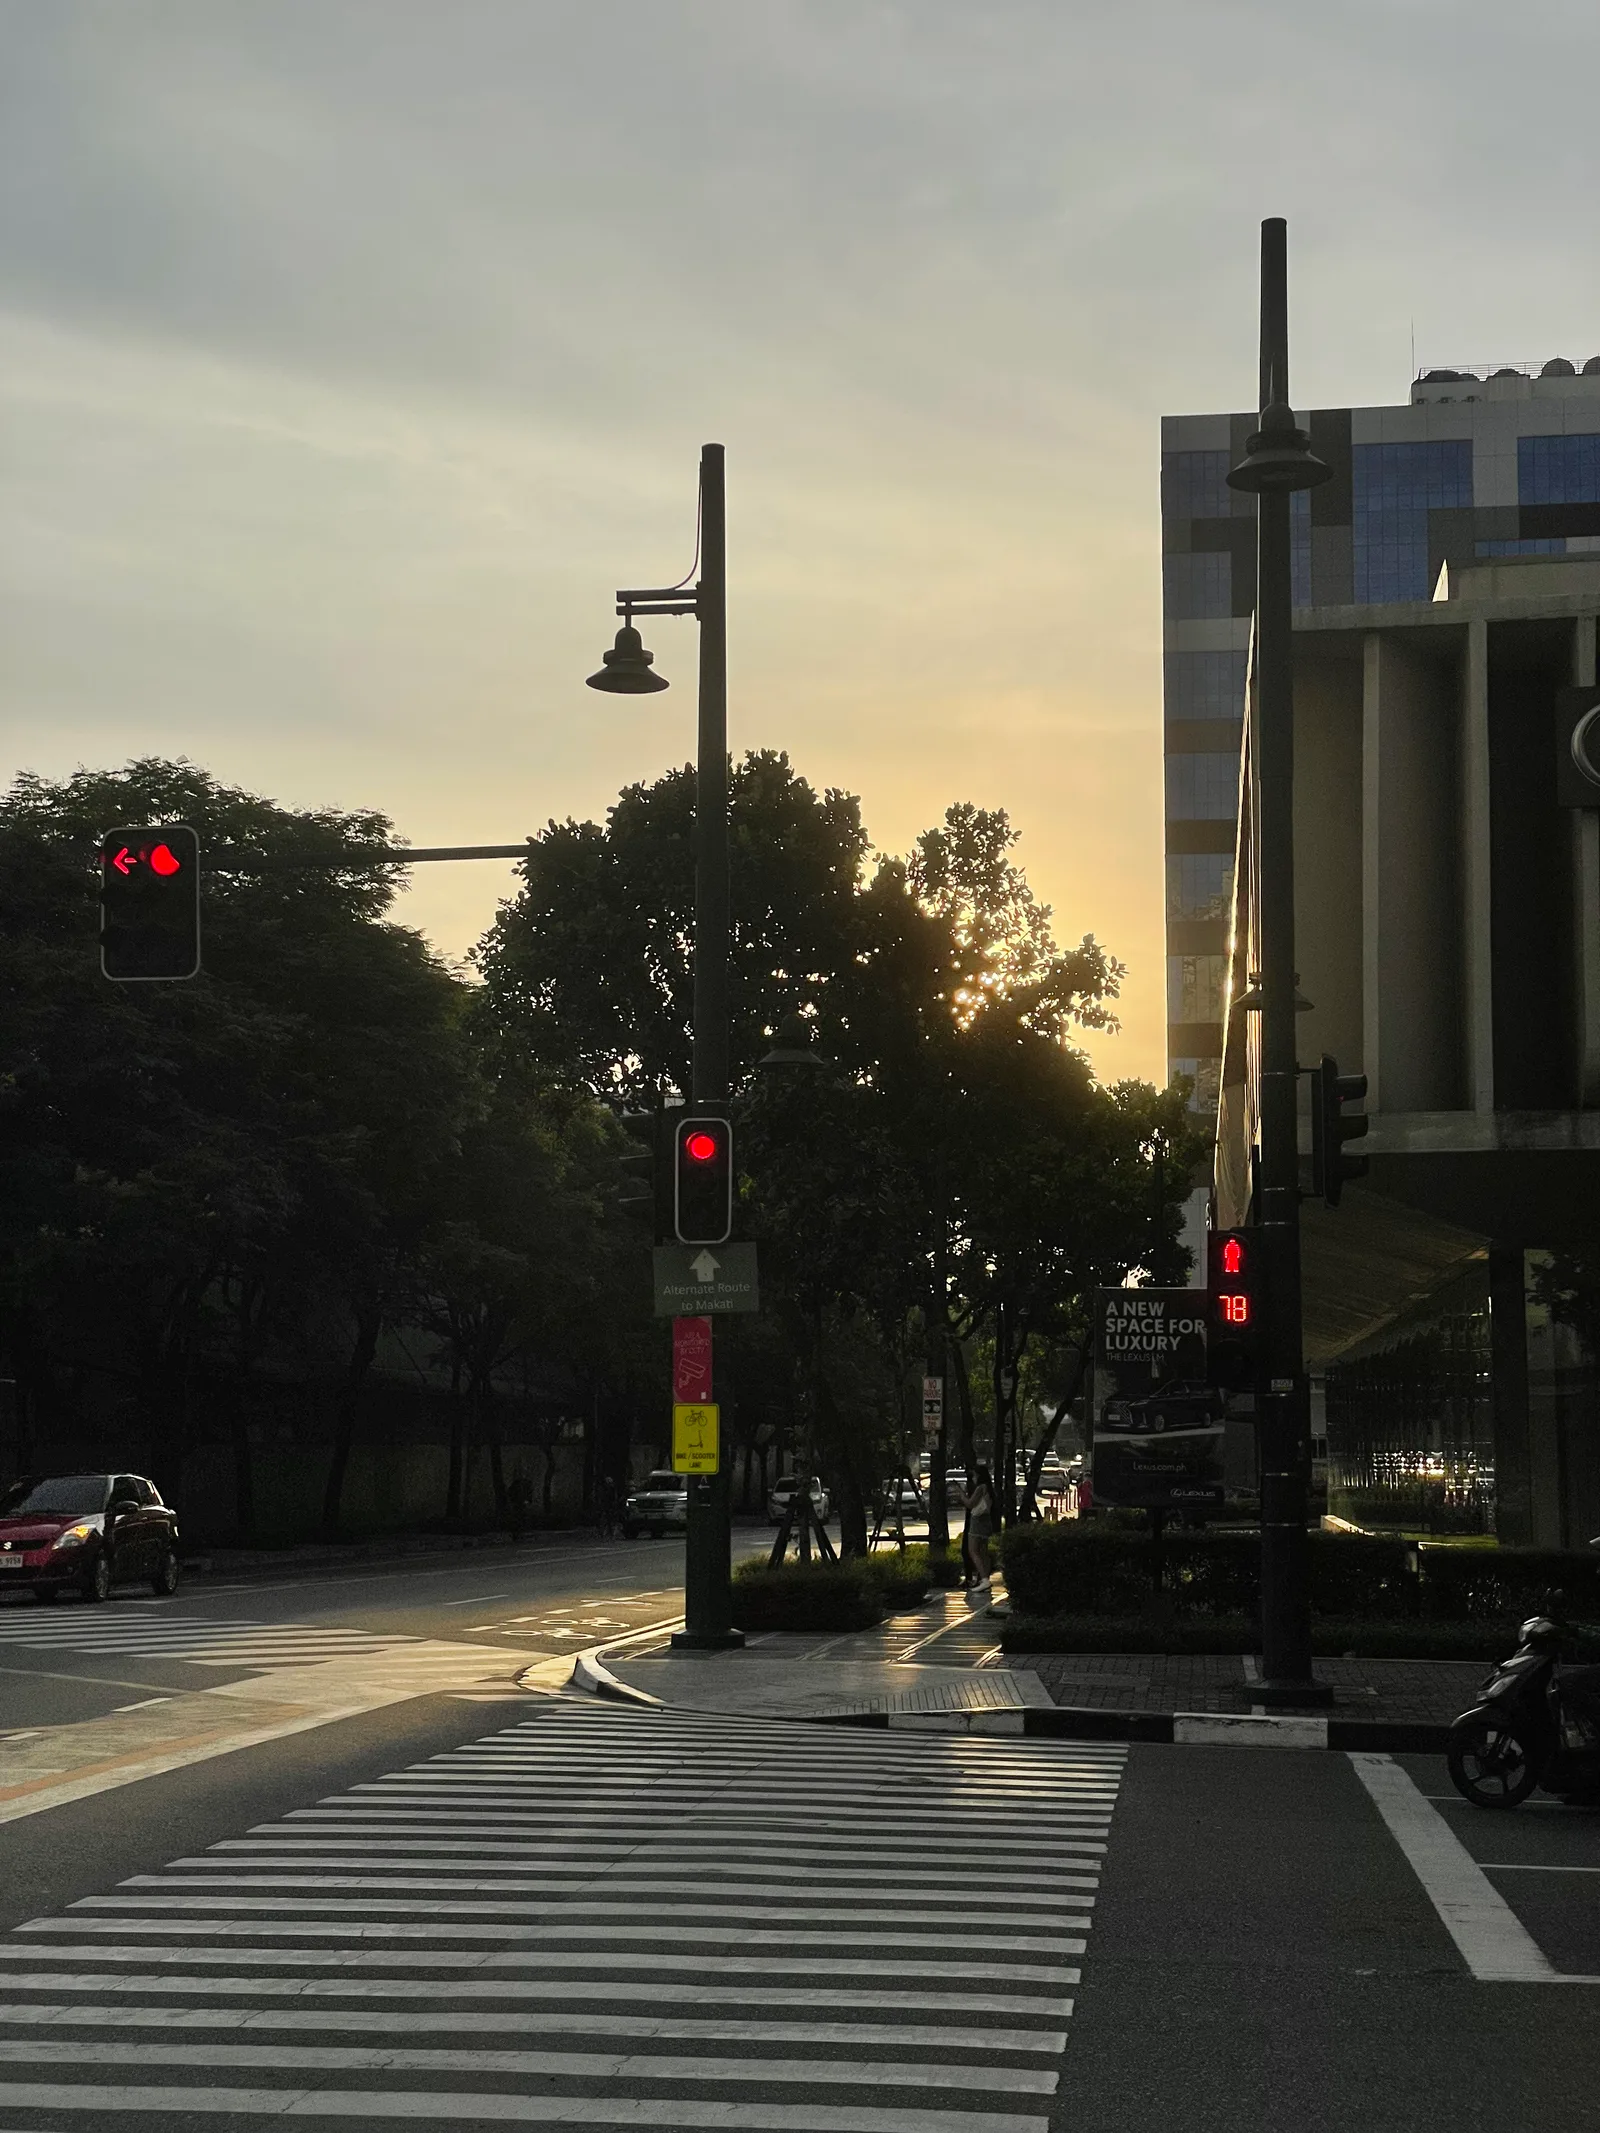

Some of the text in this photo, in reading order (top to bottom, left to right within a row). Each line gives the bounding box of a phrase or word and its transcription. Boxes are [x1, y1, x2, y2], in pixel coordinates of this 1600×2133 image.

[663, 1283, 751, 1295] Alternate Route
[681, 1299, 734, 1311] to Makati
[1106, 1301, 1166, 1317] A NEW
[1219, 1295, 1247, 1322] 78
[1105, 1318, 1206, 1334] SPACE FOR
[1105, 1335, 1182, 1351] LUXURY
[1106, 1353, 1121, 1361] THE
[1123, 1353, 1151, 1362] LEXUS
